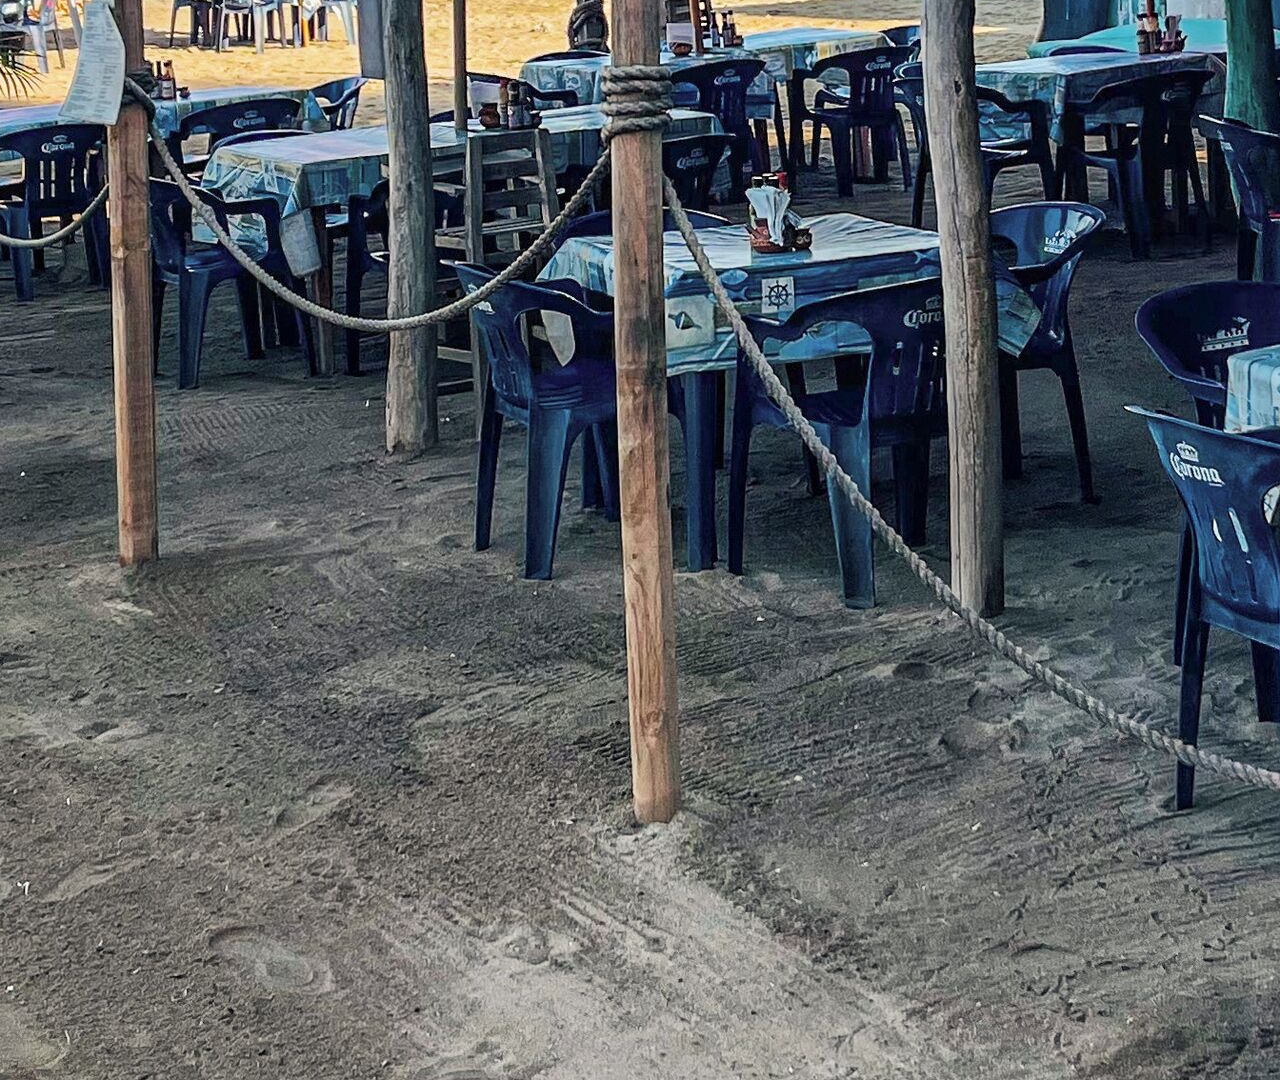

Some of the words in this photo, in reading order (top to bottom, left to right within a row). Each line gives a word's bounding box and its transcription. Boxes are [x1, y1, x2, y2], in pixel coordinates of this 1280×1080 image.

[41, 142, 75, 153] Corona
[903, 309, 941, 329] Coro
[1170, 452, 1225, 487] Corona
